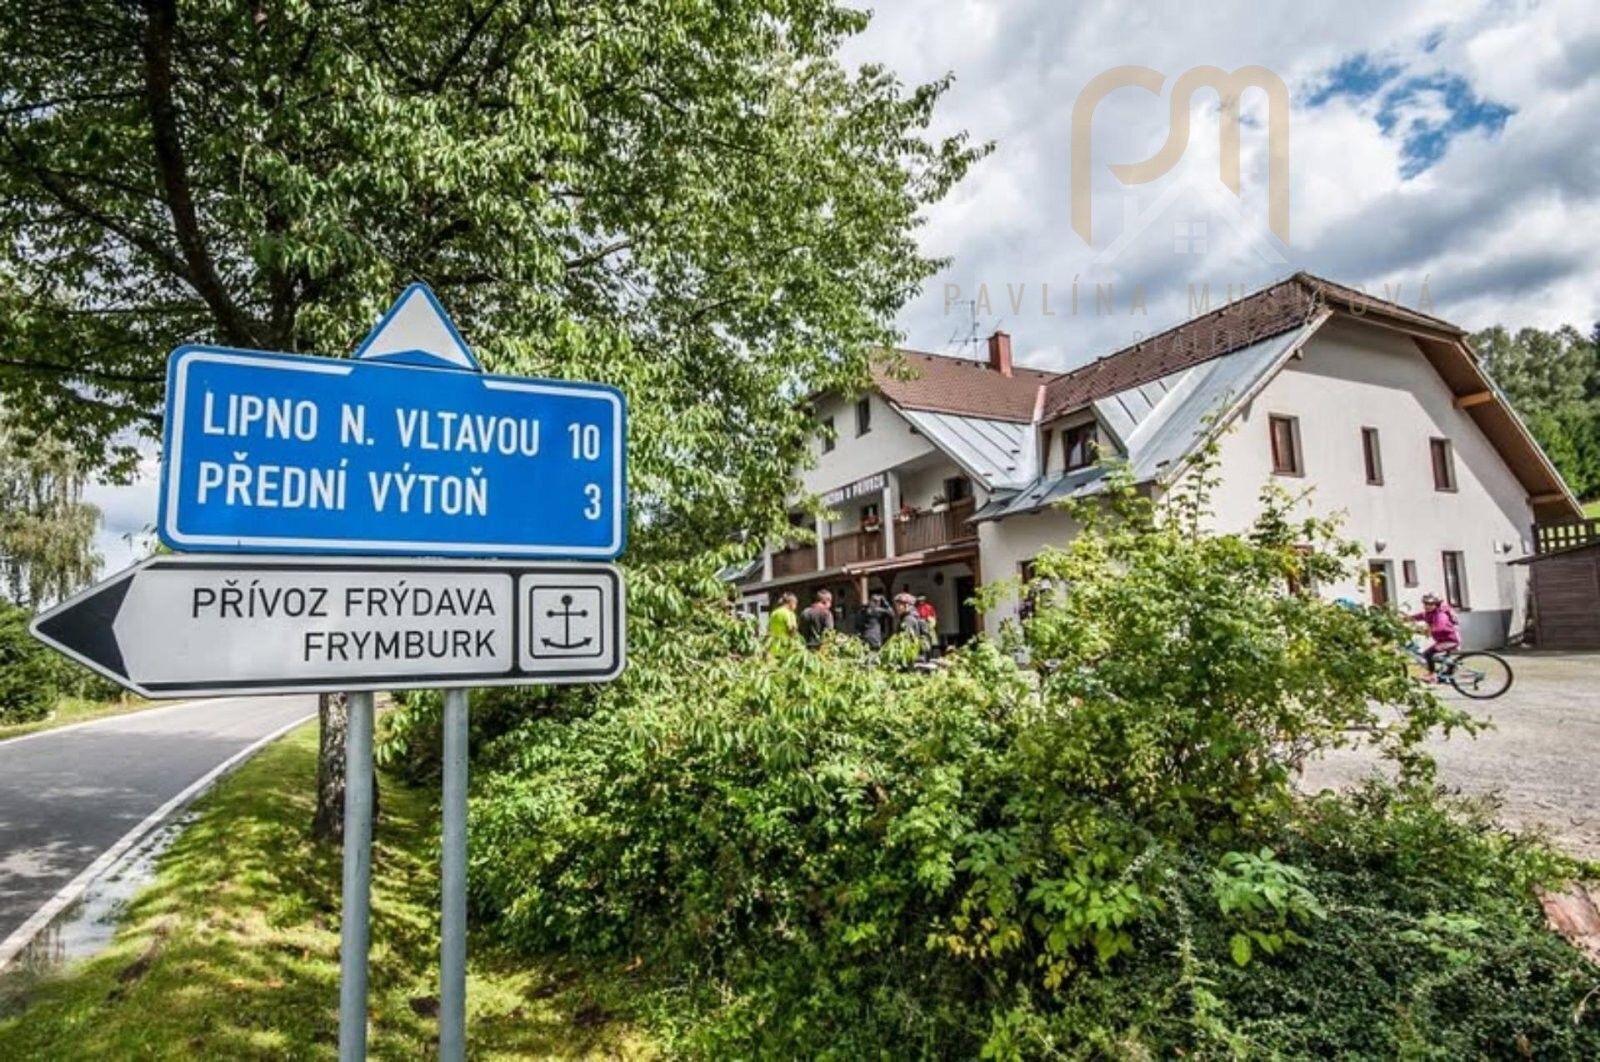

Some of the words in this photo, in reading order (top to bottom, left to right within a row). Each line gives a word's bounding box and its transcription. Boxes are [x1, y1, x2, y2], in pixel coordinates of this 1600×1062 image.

[203, 390, 318, 442] LIPNO
[340, 403, 375, 446] N.
[396, 408, 540, 457] VLTAVOU
[567, 422, 601, 461] 10
[197, 451, 349, 511] PŘEDNÍ
[368, 462, 488, 517] VÝTOŇ
[583, 483, 602, 521] 3
[192, 579, 329, 618] PŘÍVOZ
[344, 580, 496, 616] FRÝDAVA
[303, 629, 497, 661] FRYMBURK
